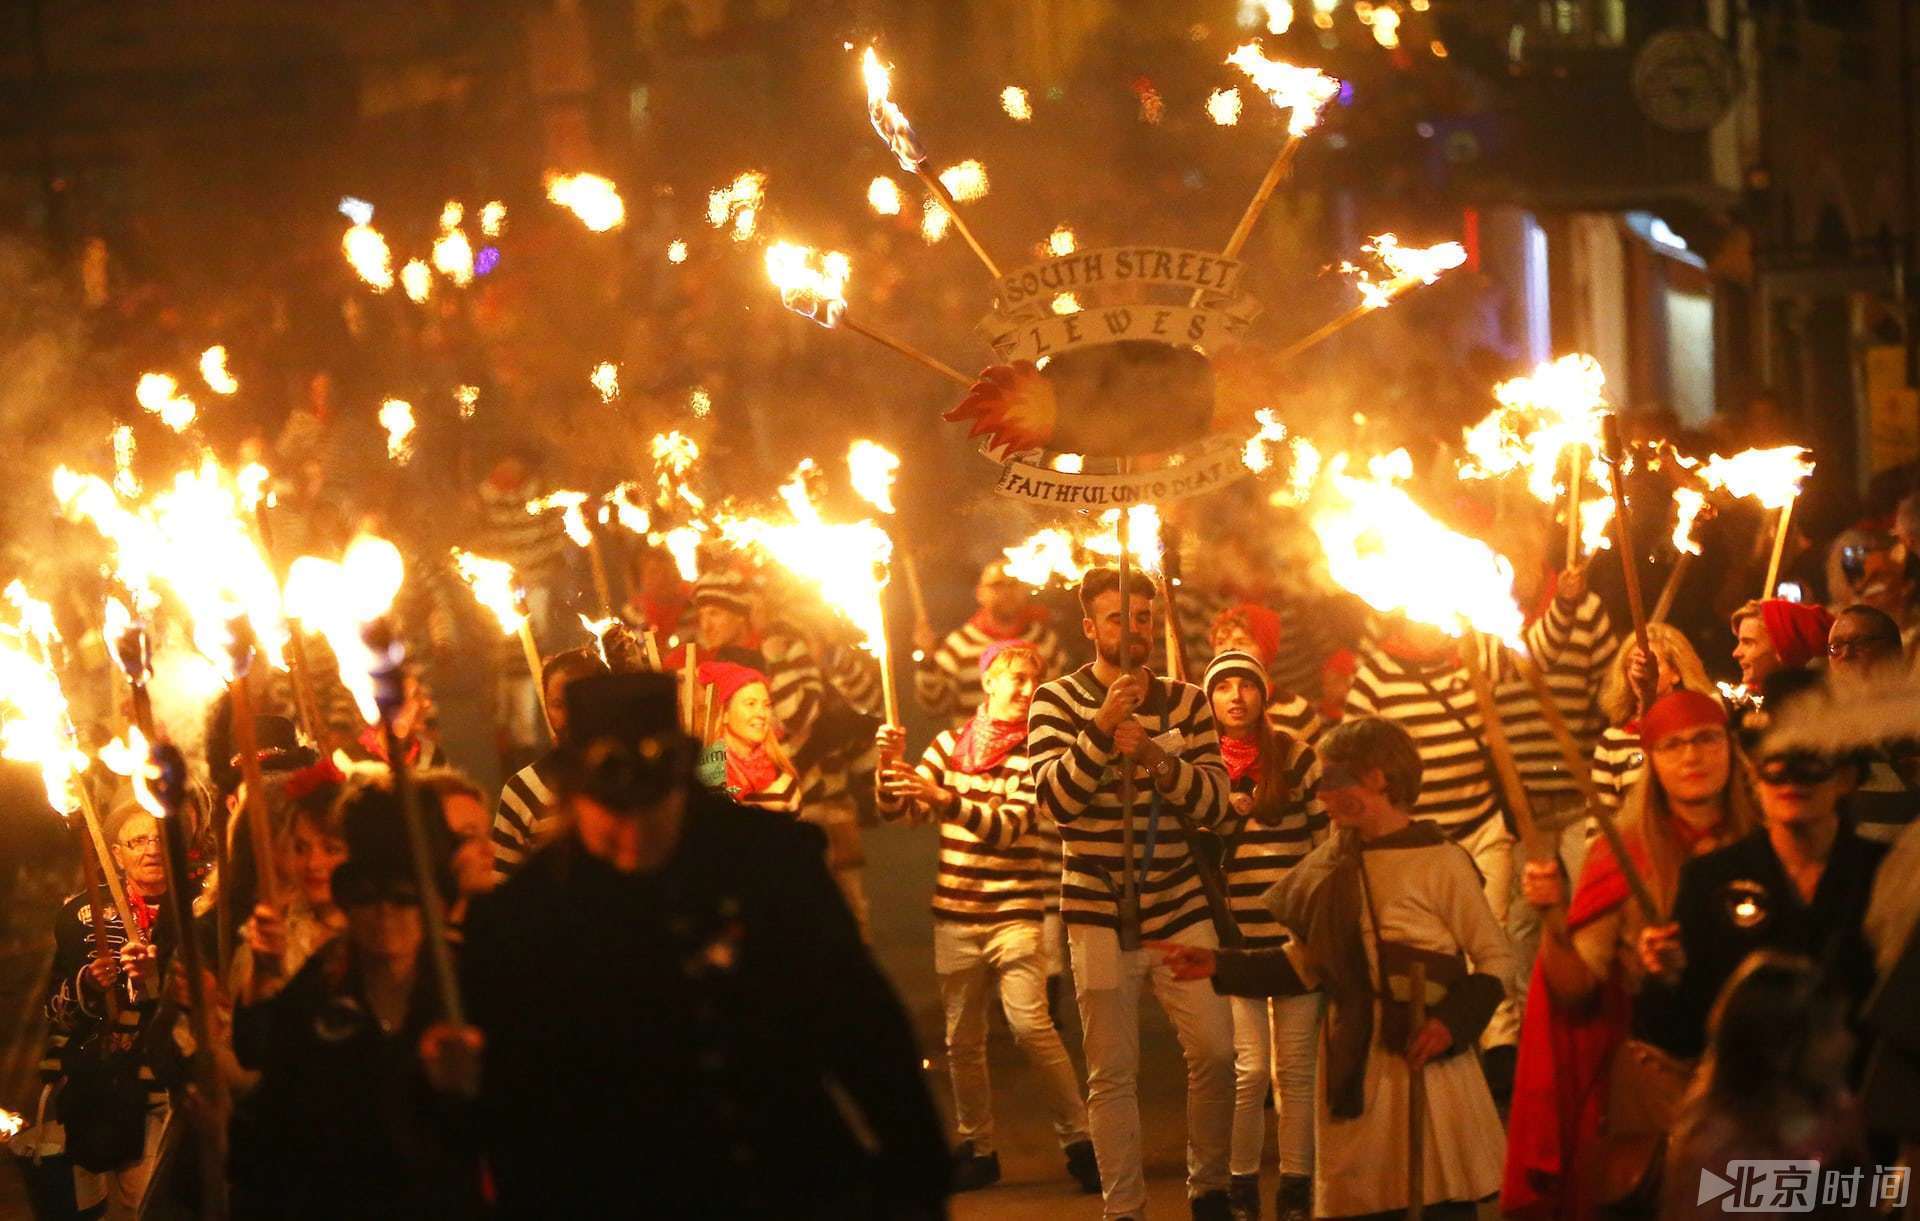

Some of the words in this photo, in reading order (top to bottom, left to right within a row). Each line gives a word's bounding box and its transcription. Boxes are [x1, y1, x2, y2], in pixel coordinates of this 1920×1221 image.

[1006, 254, 1103, 302] SOUTH
[1115, 251, 1238, 288] STREET
[1031, 308, 1206, 351] LEWES
[1006, 475, 1109, 504] FAITHFUL
